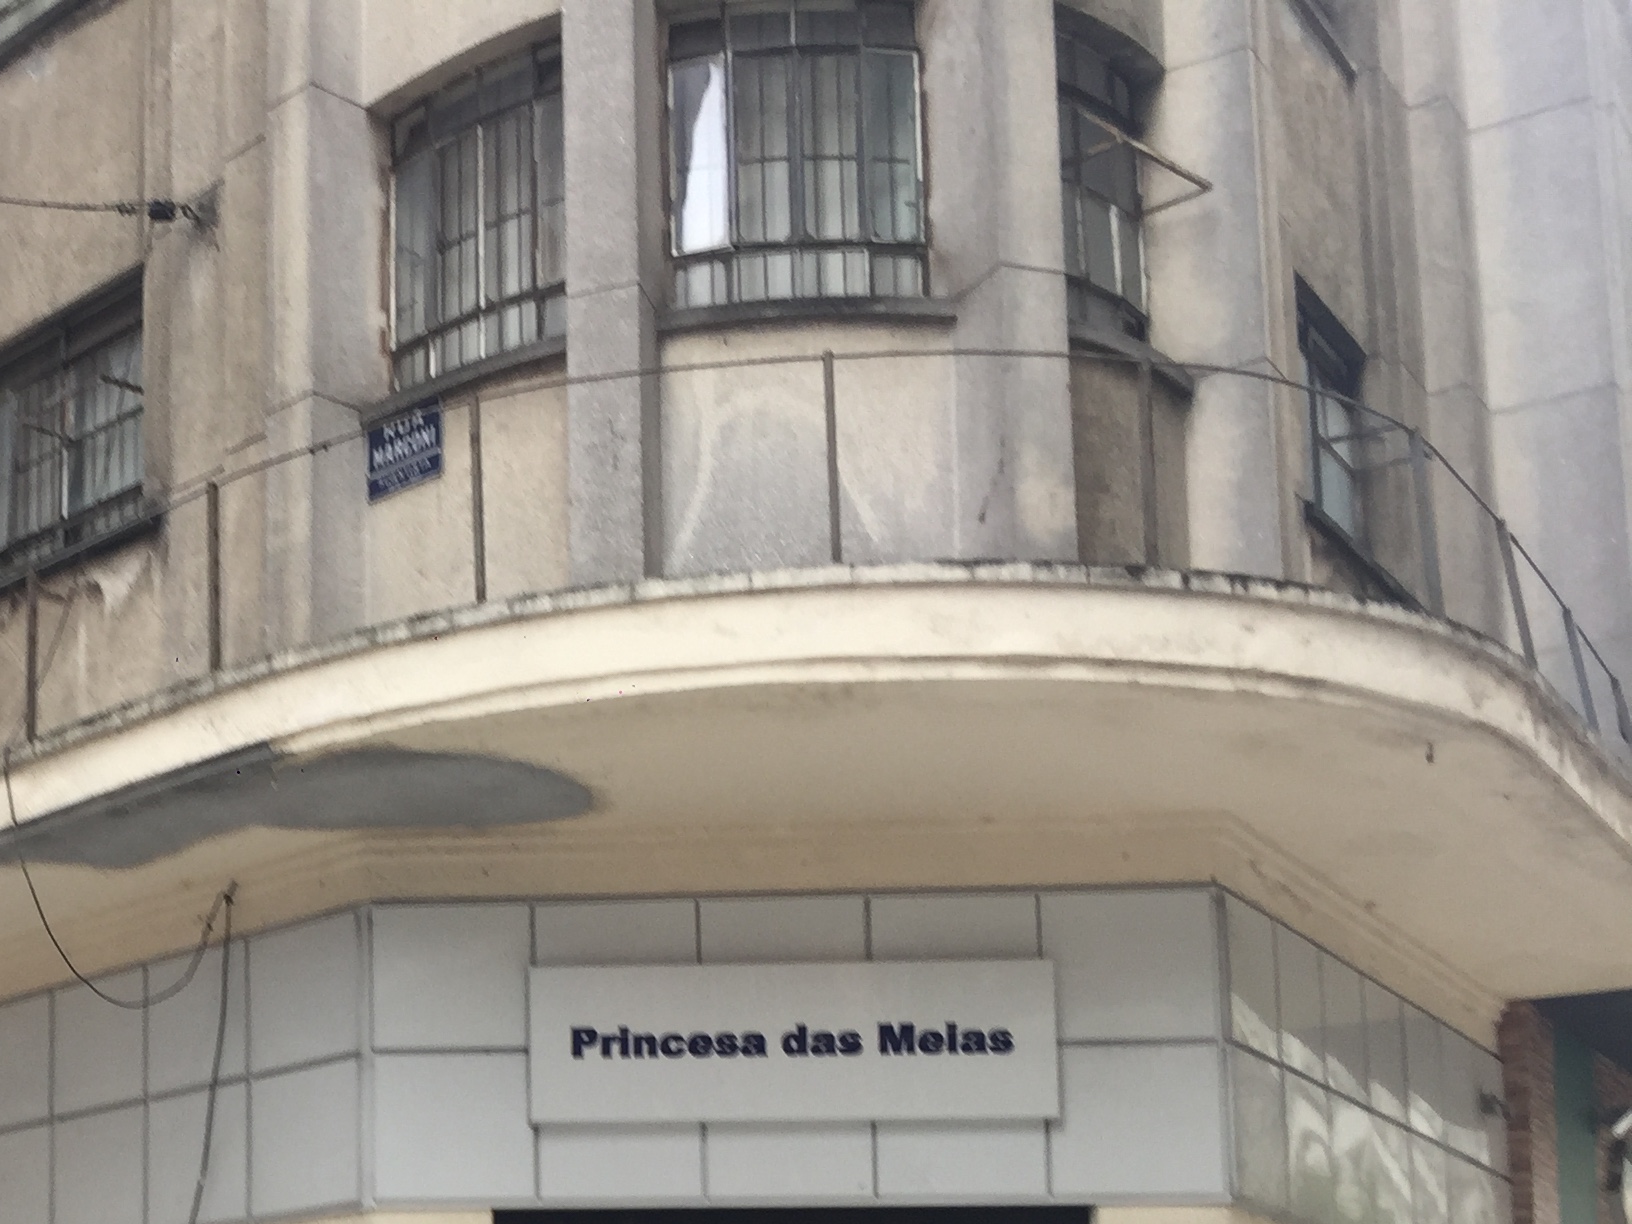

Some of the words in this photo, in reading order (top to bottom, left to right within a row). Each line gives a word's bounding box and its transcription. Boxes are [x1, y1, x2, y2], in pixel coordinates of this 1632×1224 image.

[570, 1024, 769, 1060] Princesa
[780, 1020, 865, 1057] das
[876, 1019, 1016, 1056] Meias
